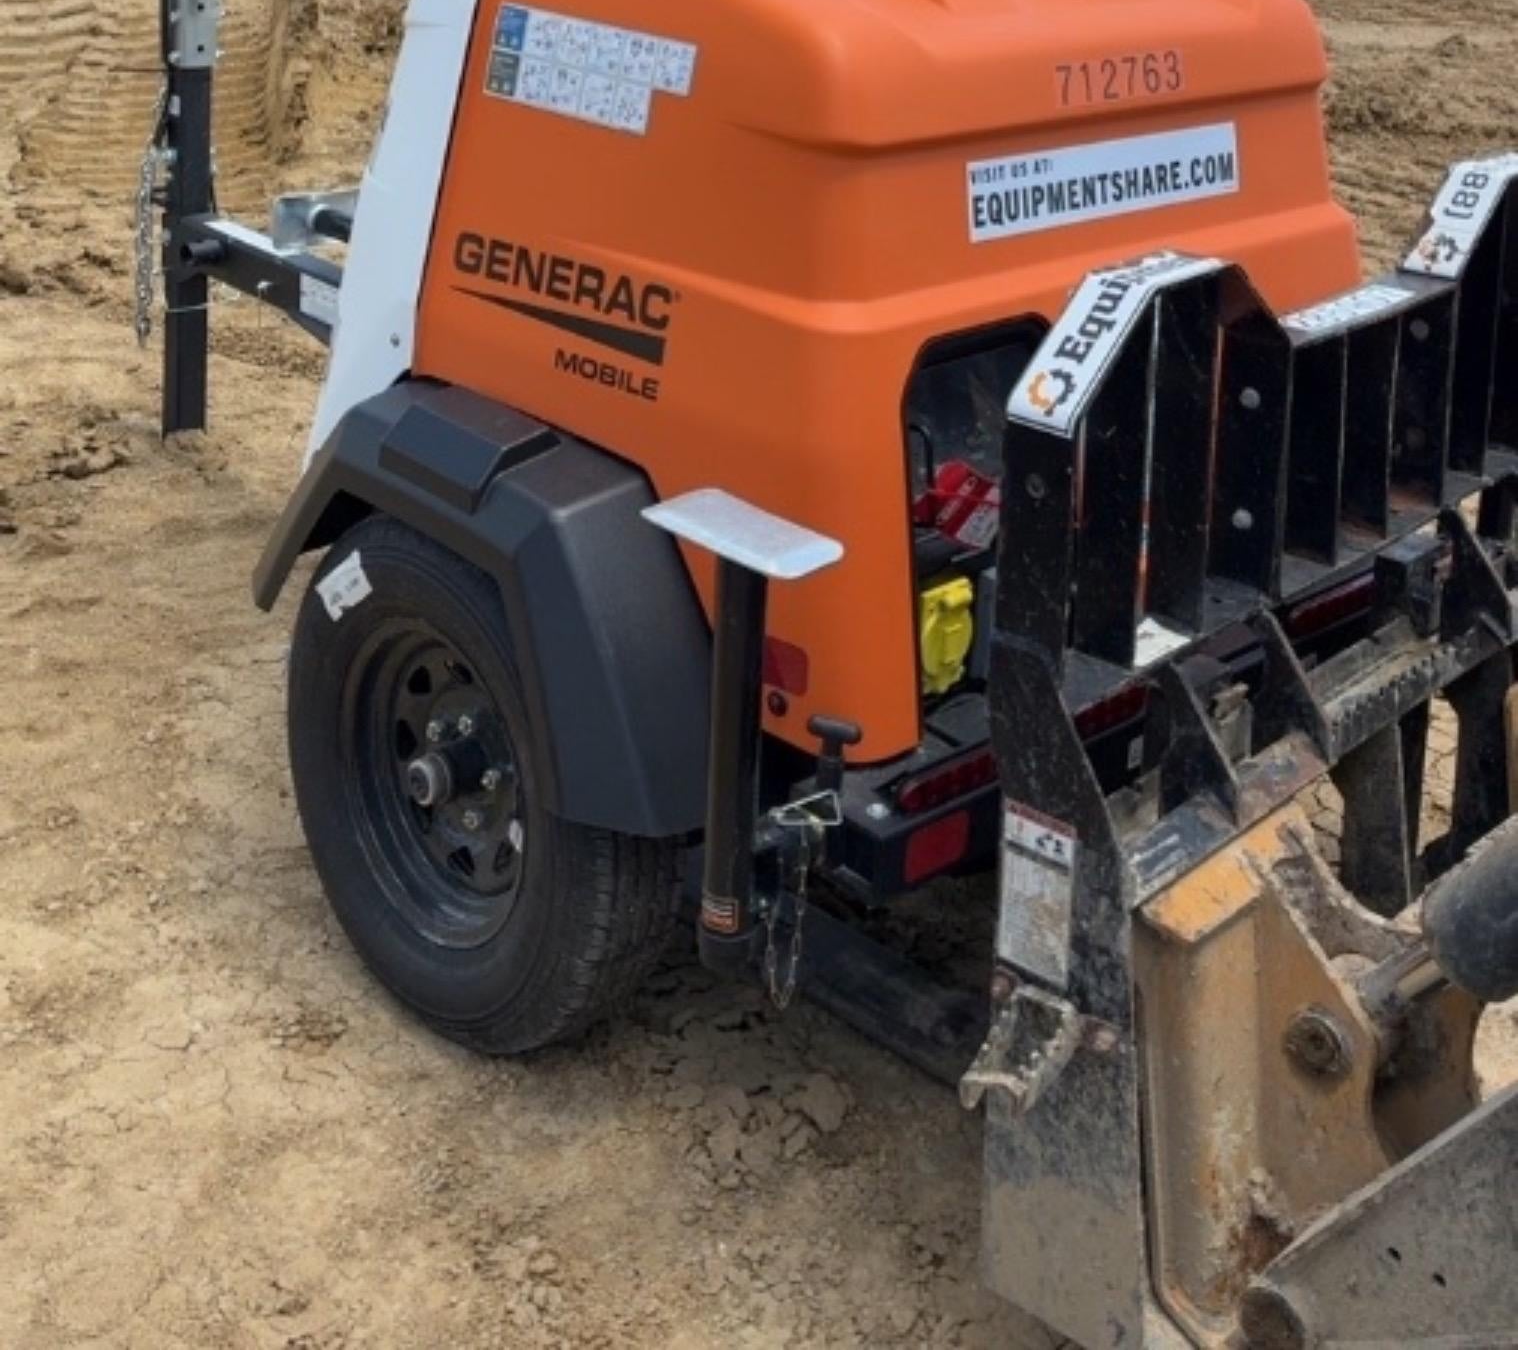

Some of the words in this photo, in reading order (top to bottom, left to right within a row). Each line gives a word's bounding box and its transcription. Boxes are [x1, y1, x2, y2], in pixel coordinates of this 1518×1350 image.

[1055, 51, 1182, 105] 712763
[972, 152, 1234, 228] EQUIPMENTSHARE.COM
[1011, 161, 1028, 179] US
[453, 232, 672, 331] GENERAC
[554, 348, 660, 402] MOBILE
